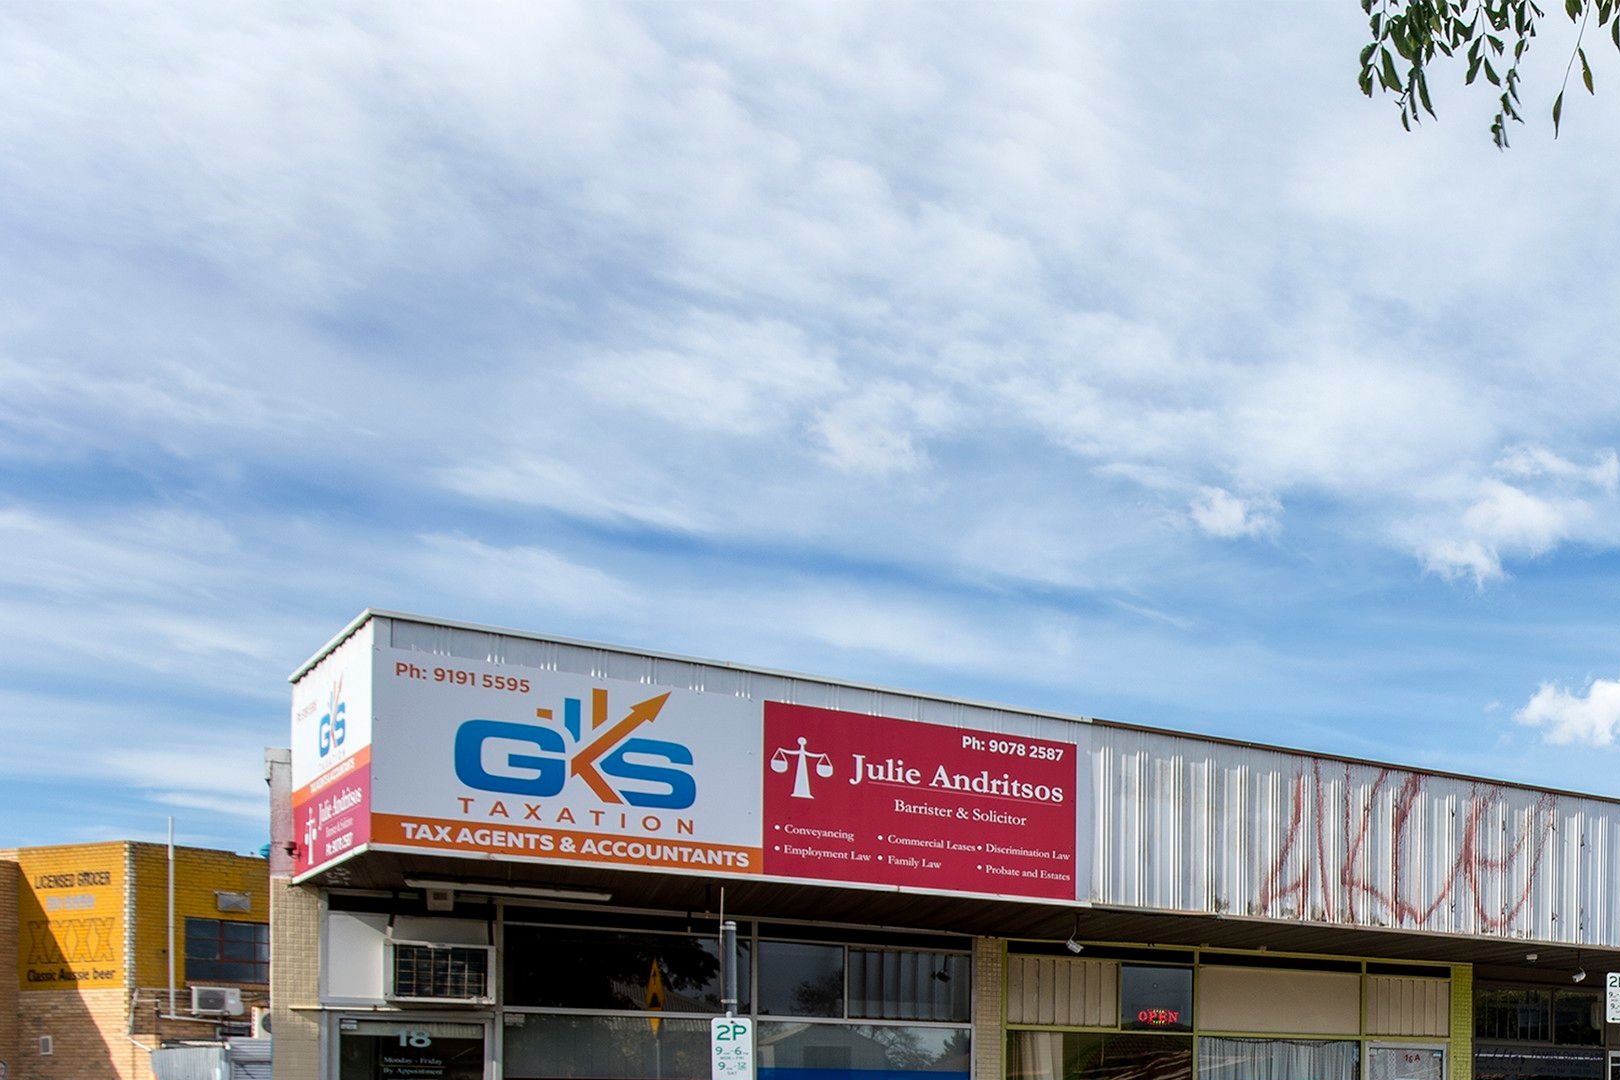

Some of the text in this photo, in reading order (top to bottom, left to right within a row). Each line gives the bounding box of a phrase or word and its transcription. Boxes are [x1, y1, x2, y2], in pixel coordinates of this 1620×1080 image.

[395, 662, 530, 693] Ph: 9191 5595
[454, 689, 697, 810] GKS
[962, 736, 1064, 762] Ph: 9078 2587
[849, 754, 1064, 803] Julie Andritsos
[457, 796, 695, 835] TAXATION
[894, 799, 1027, 826] Barrister & Solicitor
[784, 824, 854, 842] Conveyancing
[401, 822, 750, 867] TAX AGENTS & ACCOUNTANTS
[783, 844, 871, 861] Employment Law
[887, 834, 976, 852] Commercial Leases
[985, 843, 1070, 861] Discrimination Law
[888, 855, 941, 869] Family Law
[34, 870, 111, 889] LICENSED GROCER
[985, 864, 1070, 881] Probate and Estates
[27, 917, 115, 964] XXXX
[92, 966, 116, 979] beer
[1138, 1010, 1179, 1023] OPEN
[398, 1029, 432, 1048] 18
[716, 1024, 747, 1041] 2P
